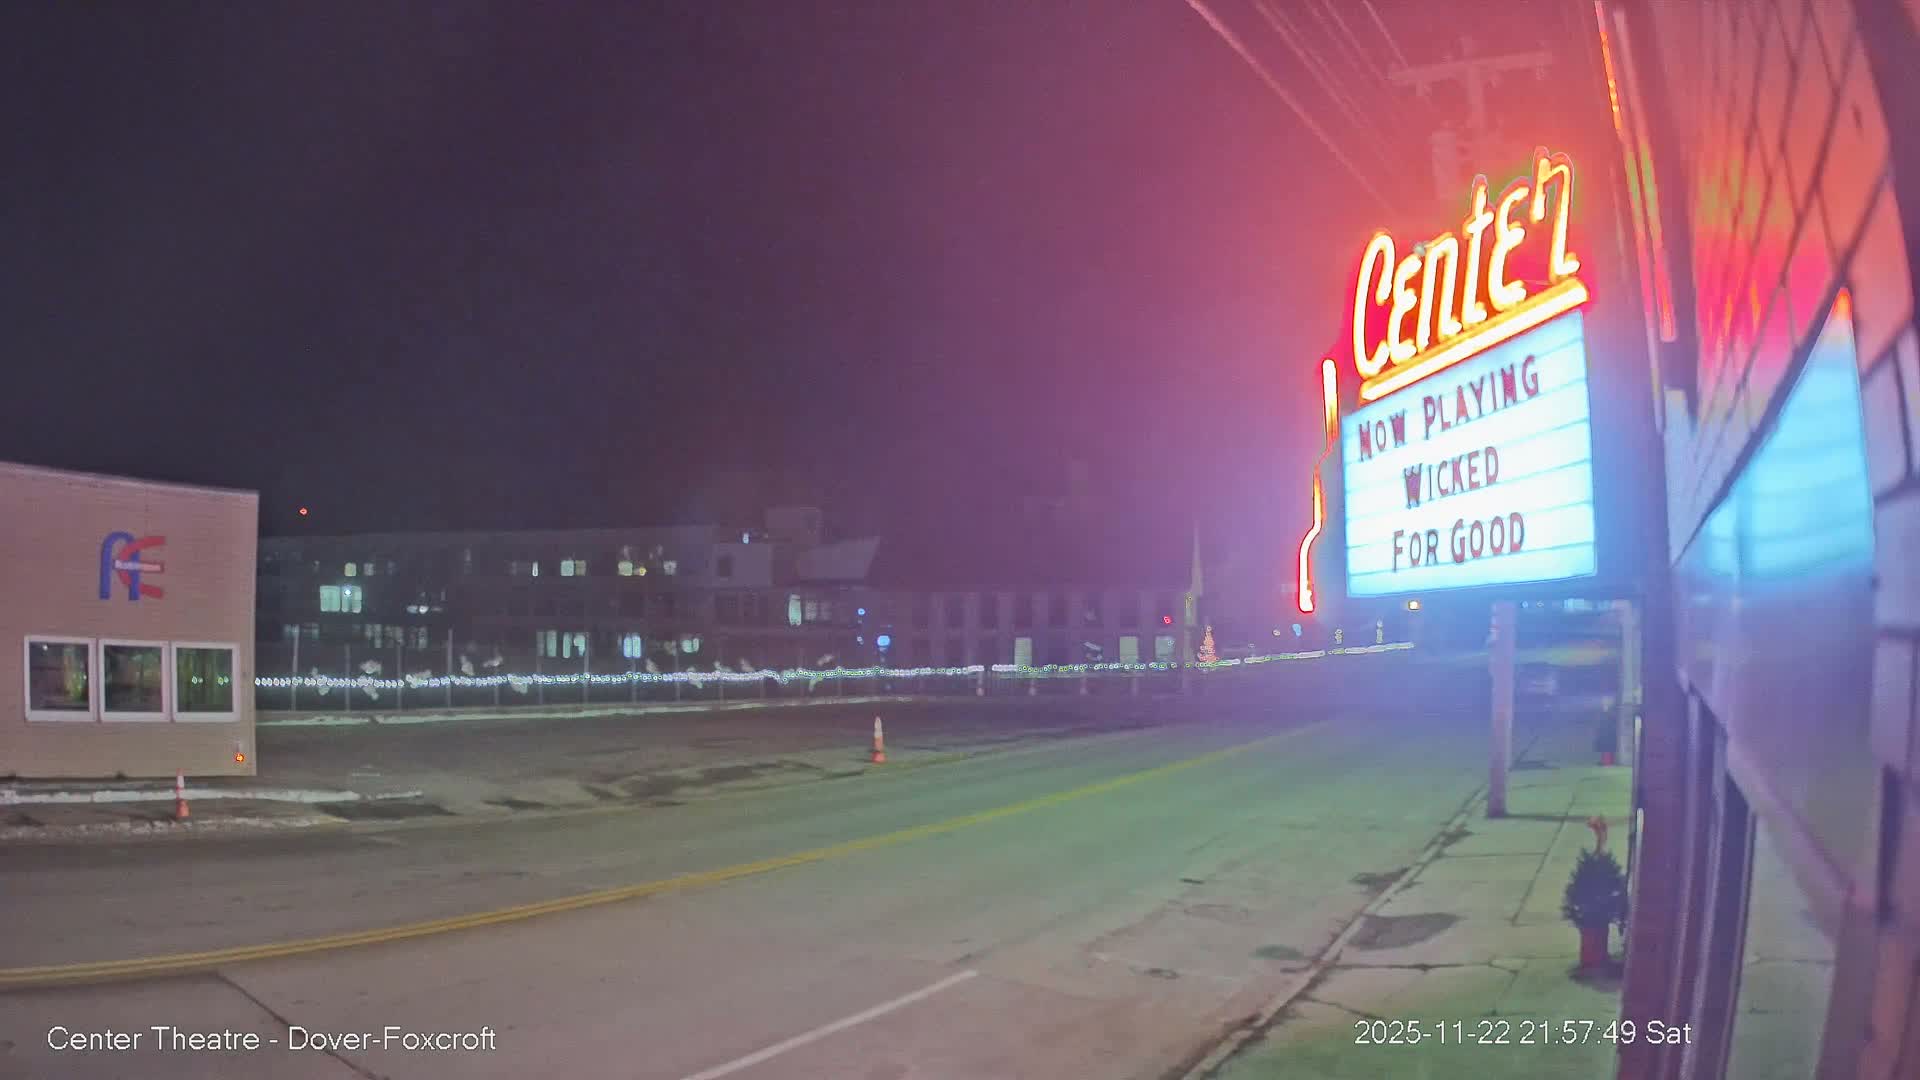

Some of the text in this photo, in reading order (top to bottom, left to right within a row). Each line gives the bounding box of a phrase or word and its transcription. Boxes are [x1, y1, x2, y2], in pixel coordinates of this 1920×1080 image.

[1359, 354, 1540, 462] NOW PLAYING
[1403, 446, 1499, 509] WICKED
[1392, 512, 1525, 572] FOR GOOD
